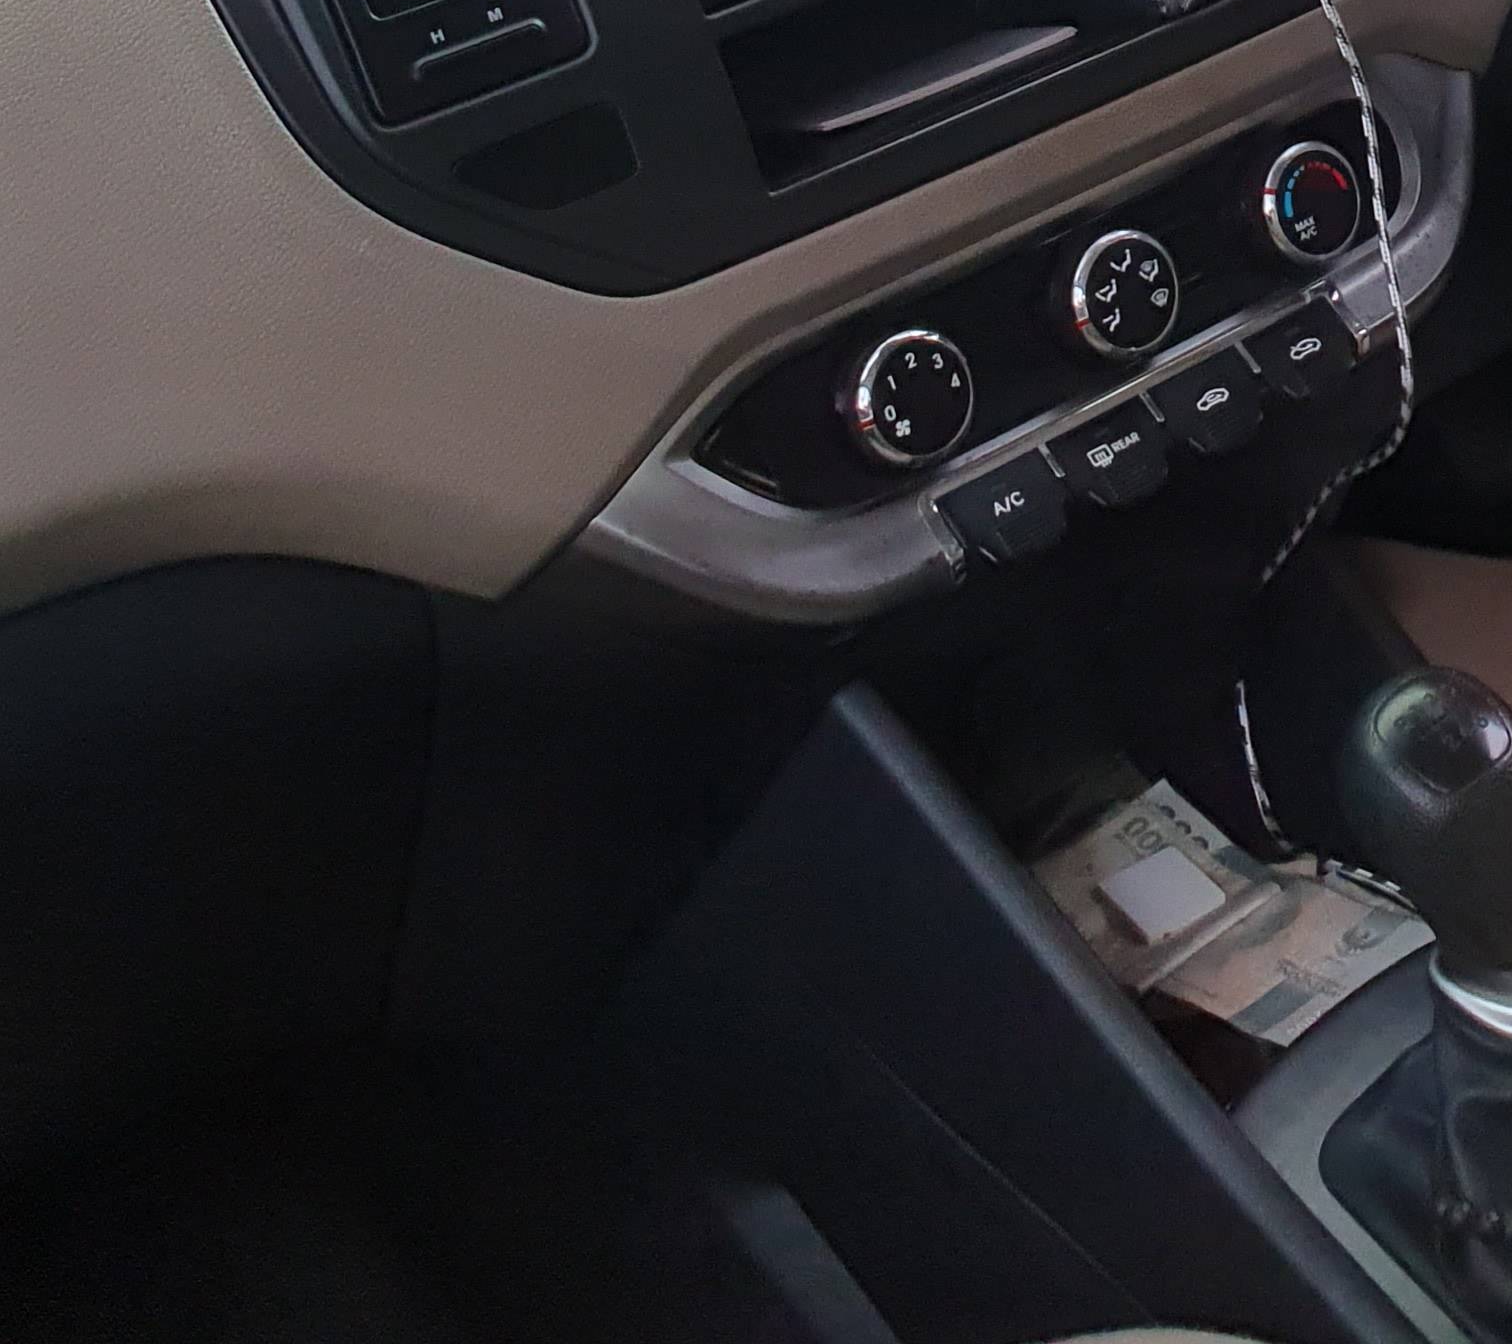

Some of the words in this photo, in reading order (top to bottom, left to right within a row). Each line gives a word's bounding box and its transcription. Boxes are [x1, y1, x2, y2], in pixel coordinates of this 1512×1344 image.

[487, 7, 504, 23] M
[430, 28, 446, 45] H
[904, 352, 918, 369] 2
[931, 352, 944, 369] 3
[887, 375, 897, 391] 1
[951, 372, 961, 388] 4
[884, 405, 897, 422] 0
[1110, 431, 1141, 454] REAR
[993, 490, 1025, 518] A/C
